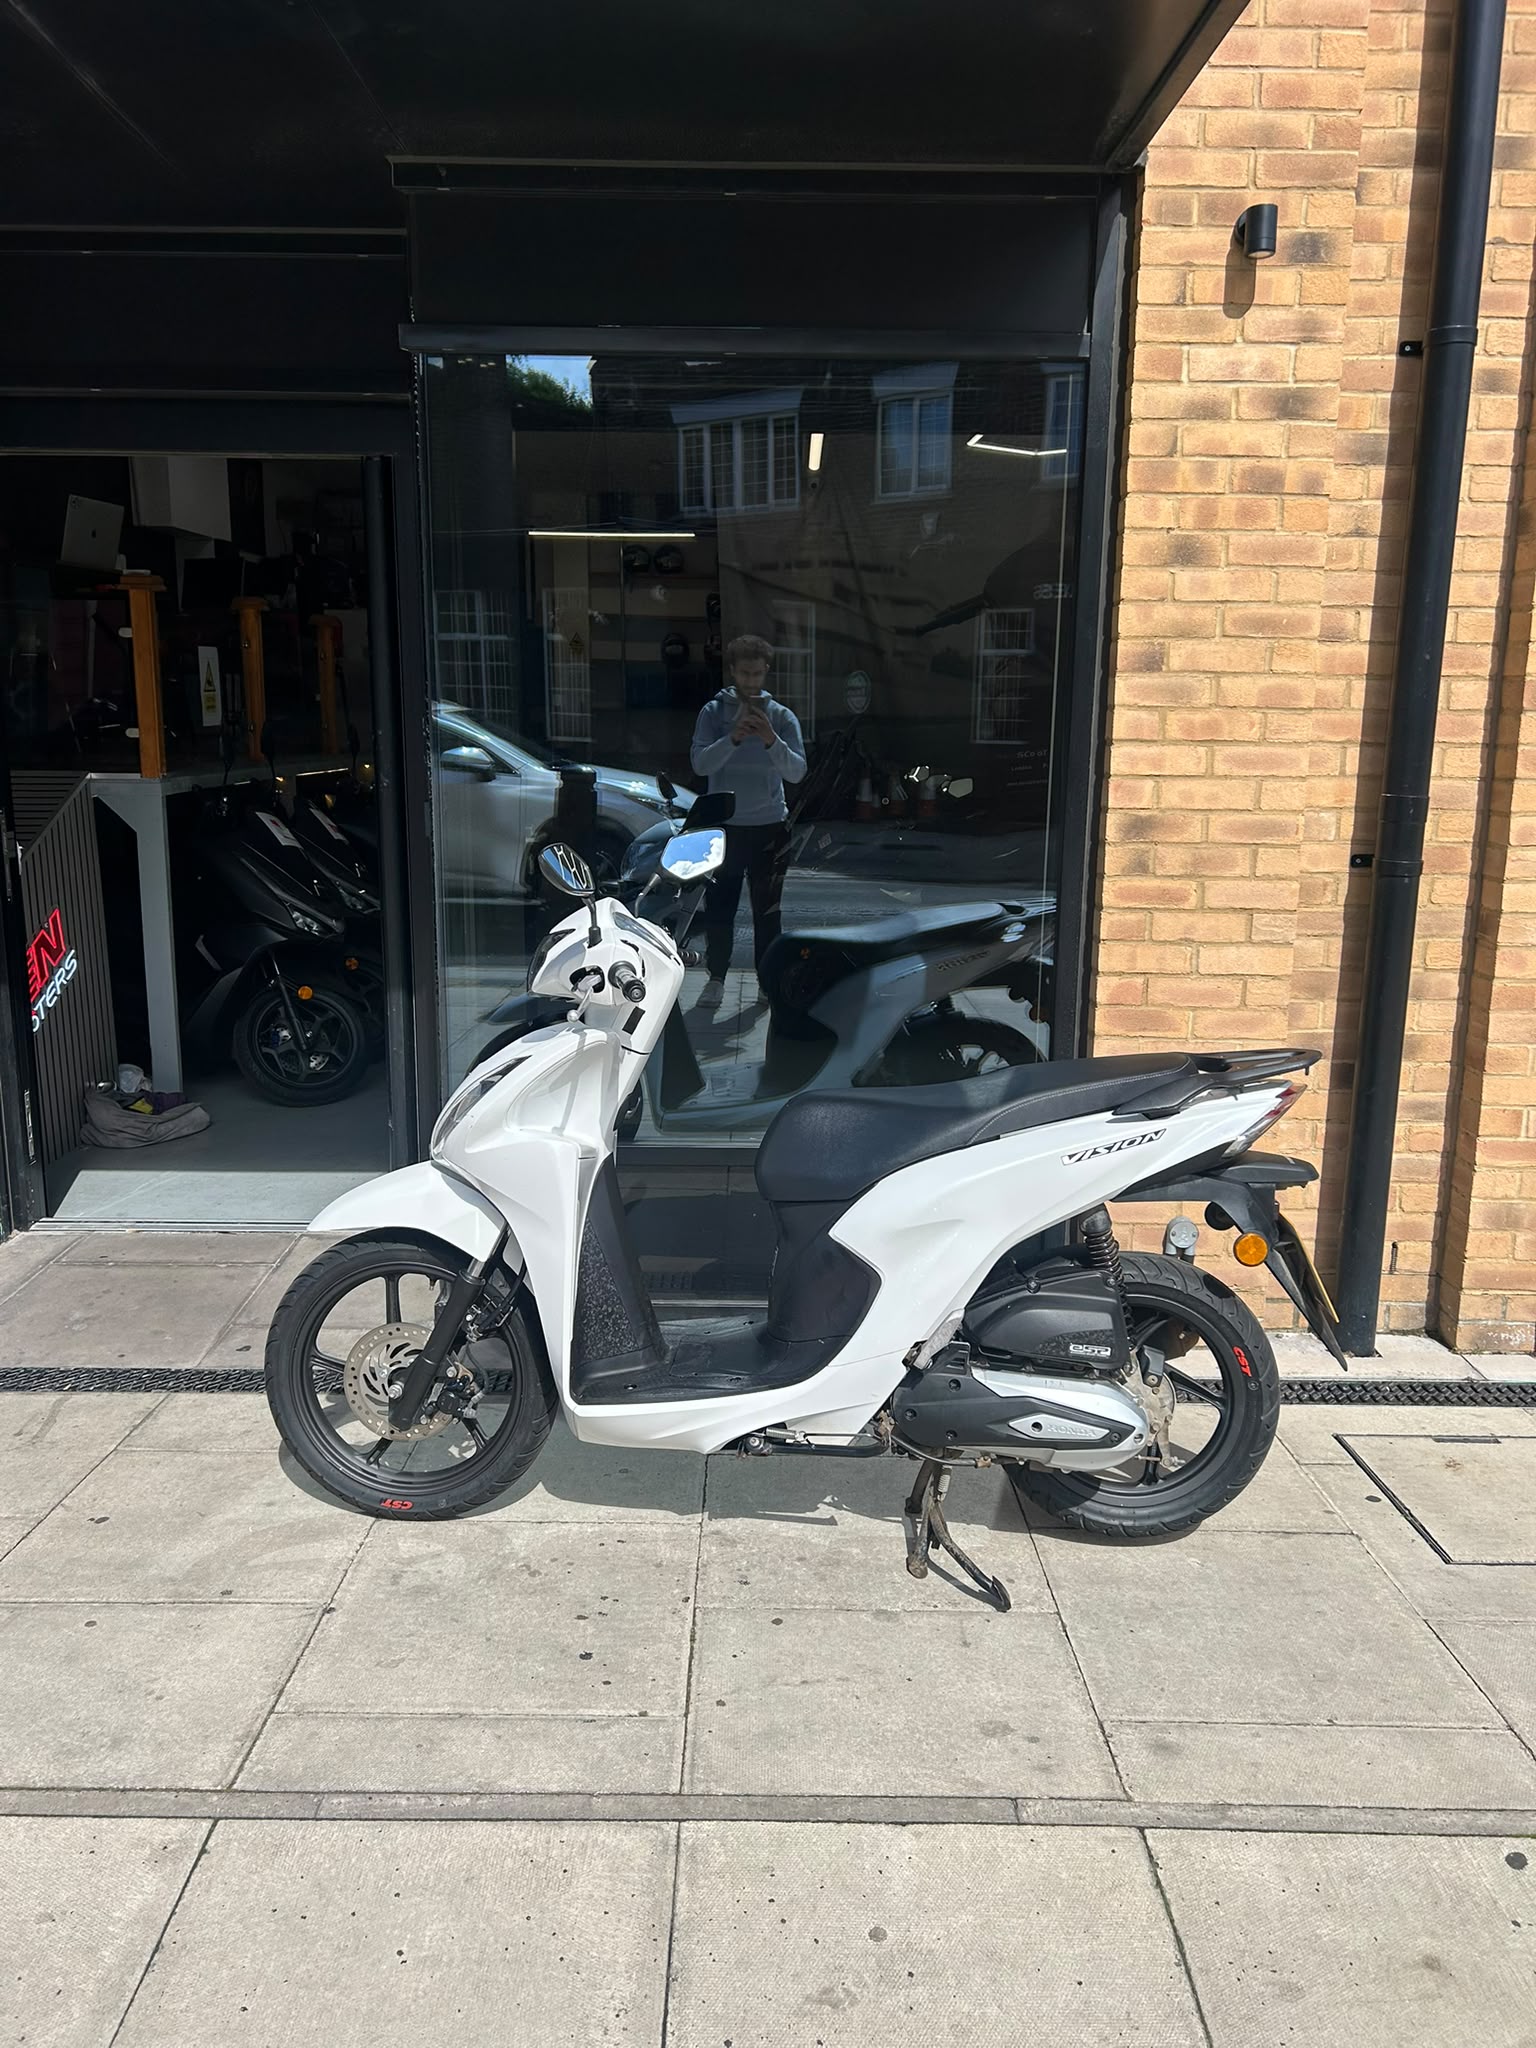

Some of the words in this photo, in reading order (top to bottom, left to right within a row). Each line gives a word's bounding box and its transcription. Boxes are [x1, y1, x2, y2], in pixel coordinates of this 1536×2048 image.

[1061, 1128, 1167, 1166] VISION
[1232, 1346, 1253, 1377] CST
[1046, 1423, 1097, 1438] HONDA
[380, 1498, 414, 1510] CST
